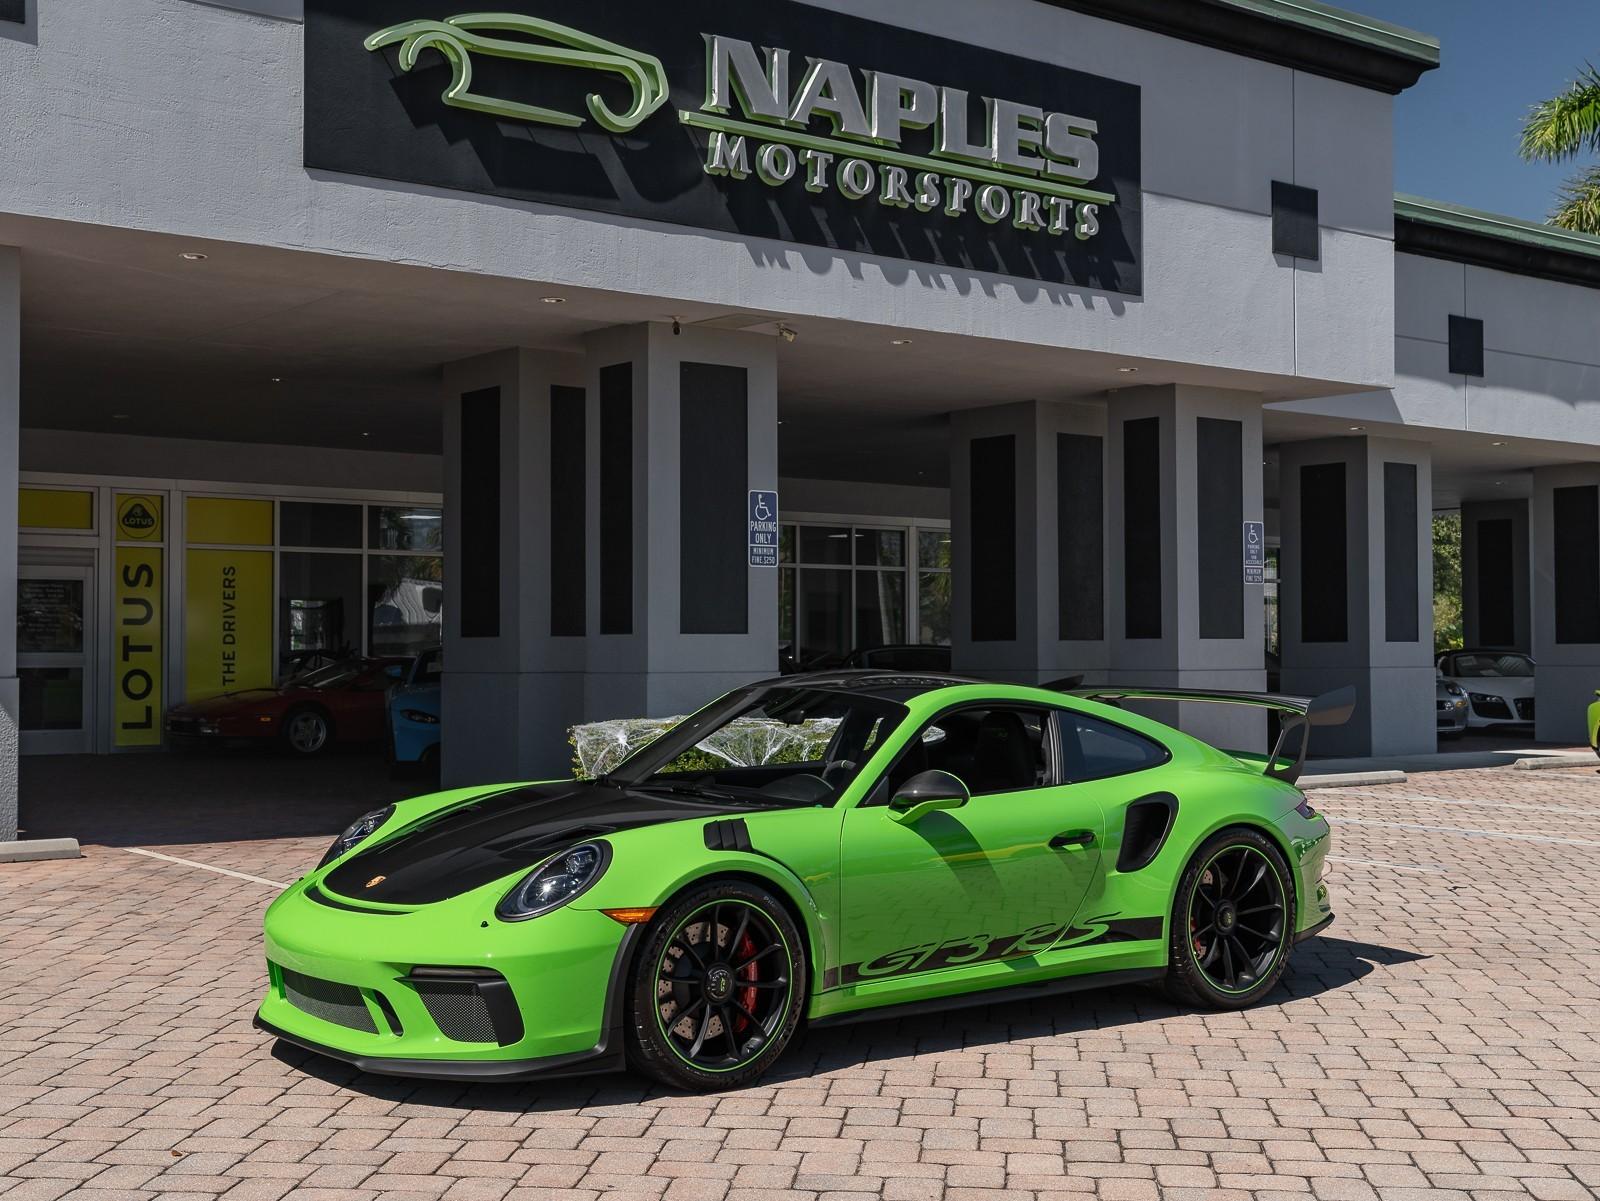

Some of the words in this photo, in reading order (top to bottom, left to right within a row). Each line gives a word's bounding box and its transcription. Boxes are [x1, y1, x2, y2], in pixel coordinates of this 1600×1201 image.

[700, 33, 1099, 184] NAPLES
[704, 131, 1100, 240] MOTORSPORTS
[124, 517, 153, 526] LOTUS
[750, 520, 777, 533] PARKING
[755, 533, 772, 544] ONLY
[752, 547, 774, 555] MINIMUM
[222, 566, 236, 645] DRIVERS
[122, 563, 154, 729] LOTUS
[222, 651, 236, 686] THE
[858, 932, 999, 976] GT3
